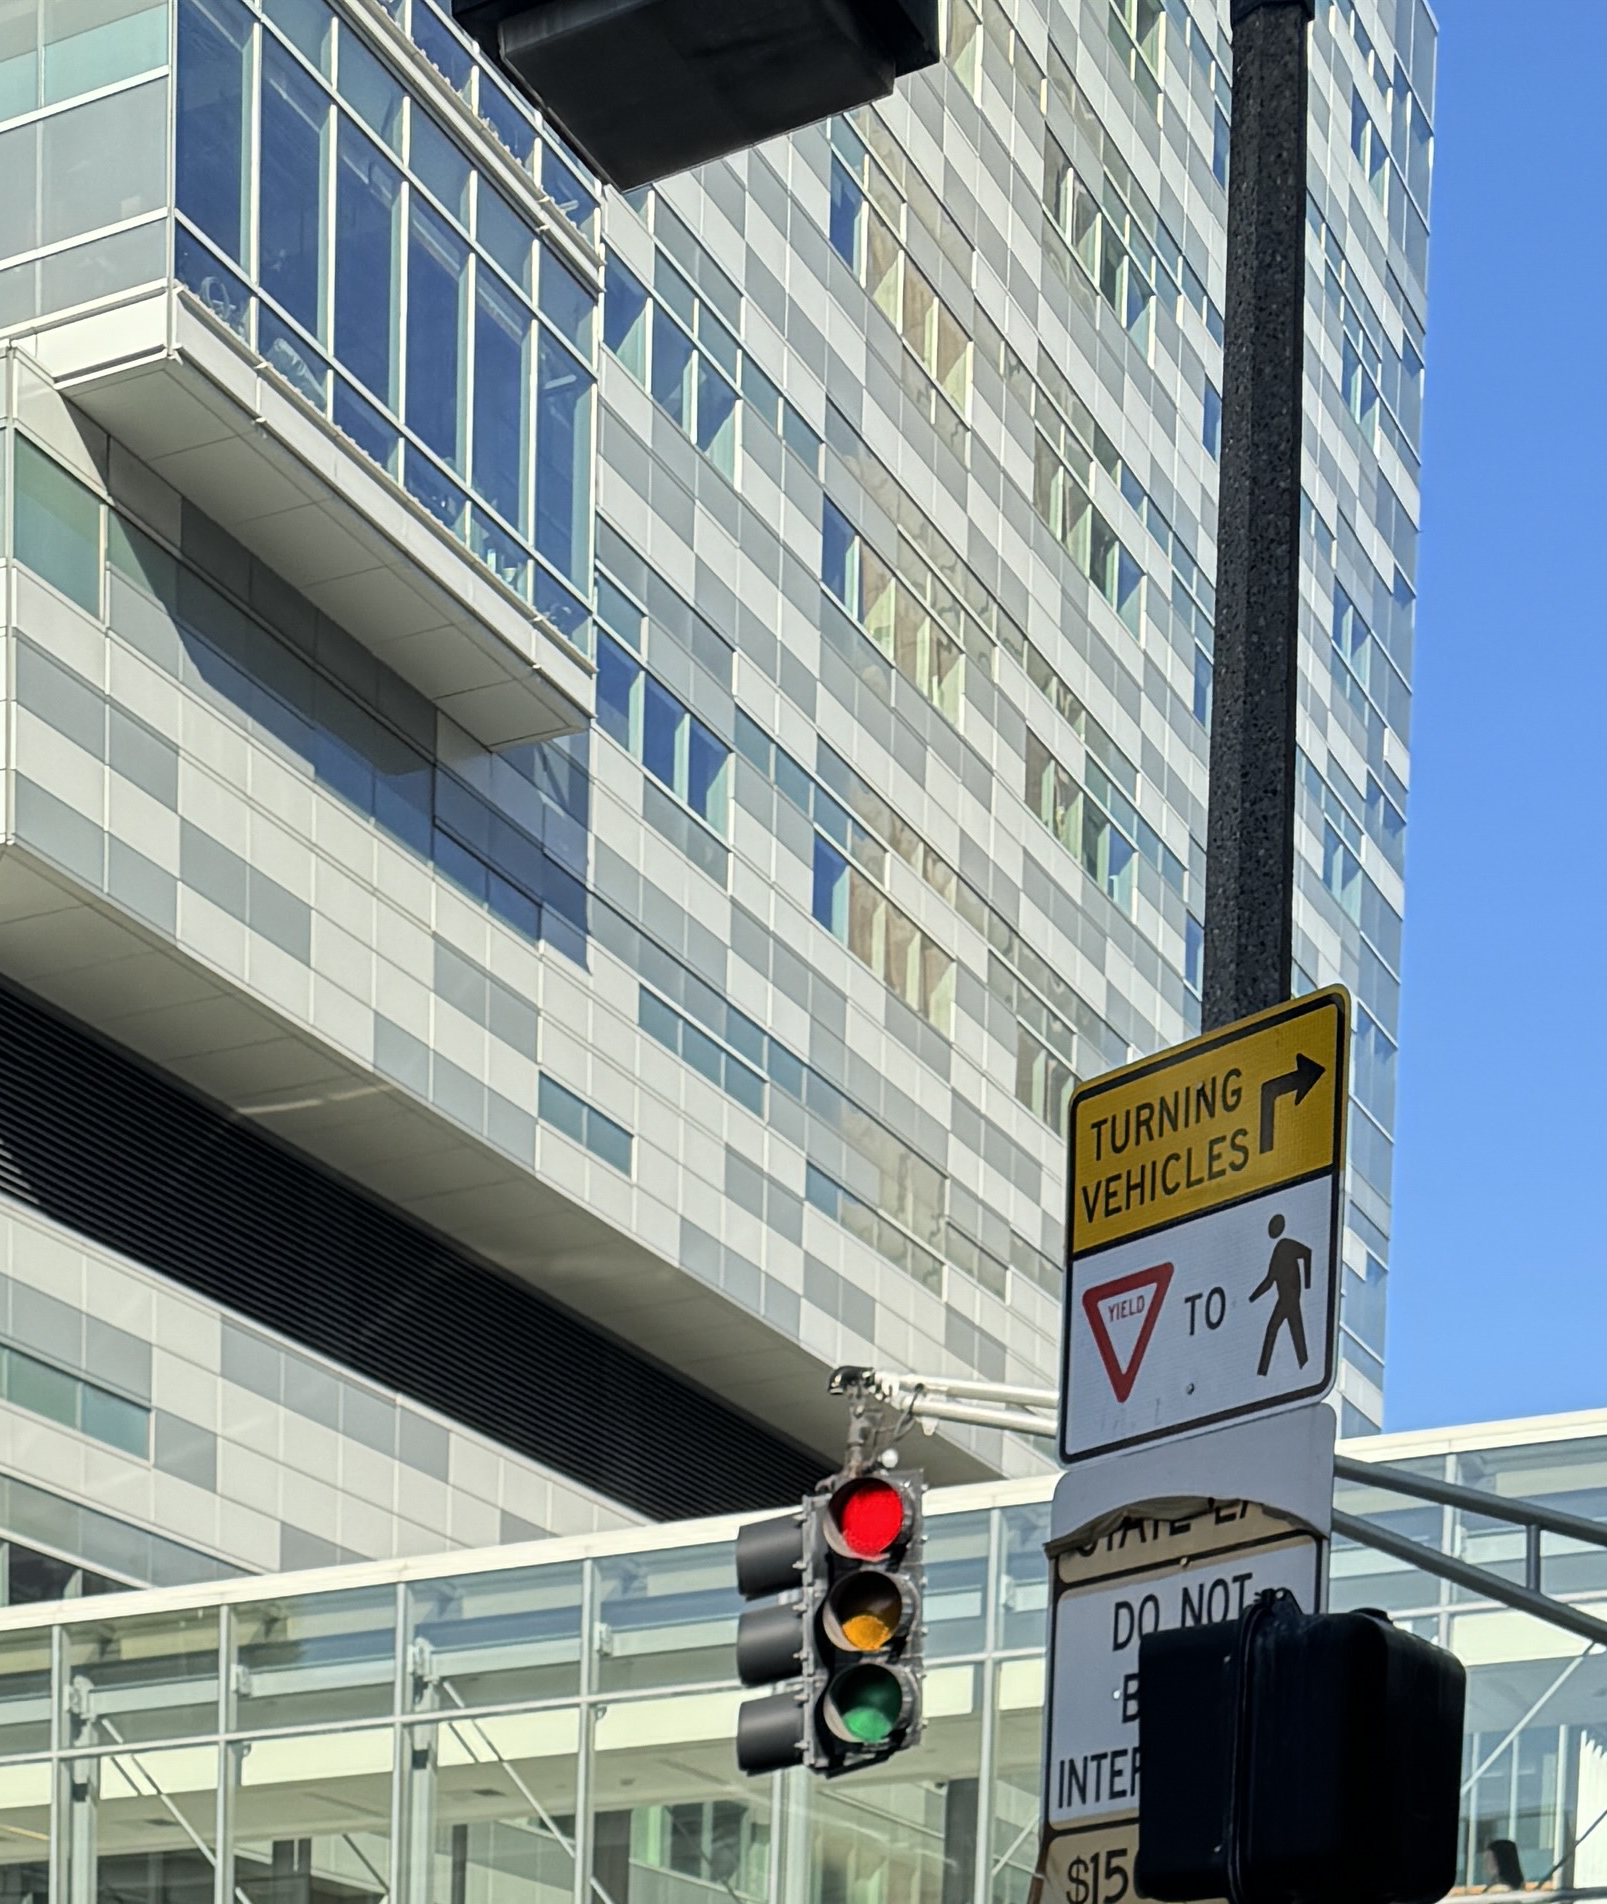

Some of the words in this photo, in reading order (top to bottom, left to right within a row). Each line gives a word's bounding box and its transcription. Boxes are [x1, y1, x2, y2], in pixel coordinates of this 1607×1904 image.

[1091, 1067, 1242, 1161] TURNING
[1082, 1128, 1249, 1223] VEHICLES
[1108, 1295, 1145, 1322] YIELD
[1184, 1286, 1226, 1336] TO
[1112, 1594, 1160, 1652] DO
[1181, 1572, 1253, 1629] NOT
